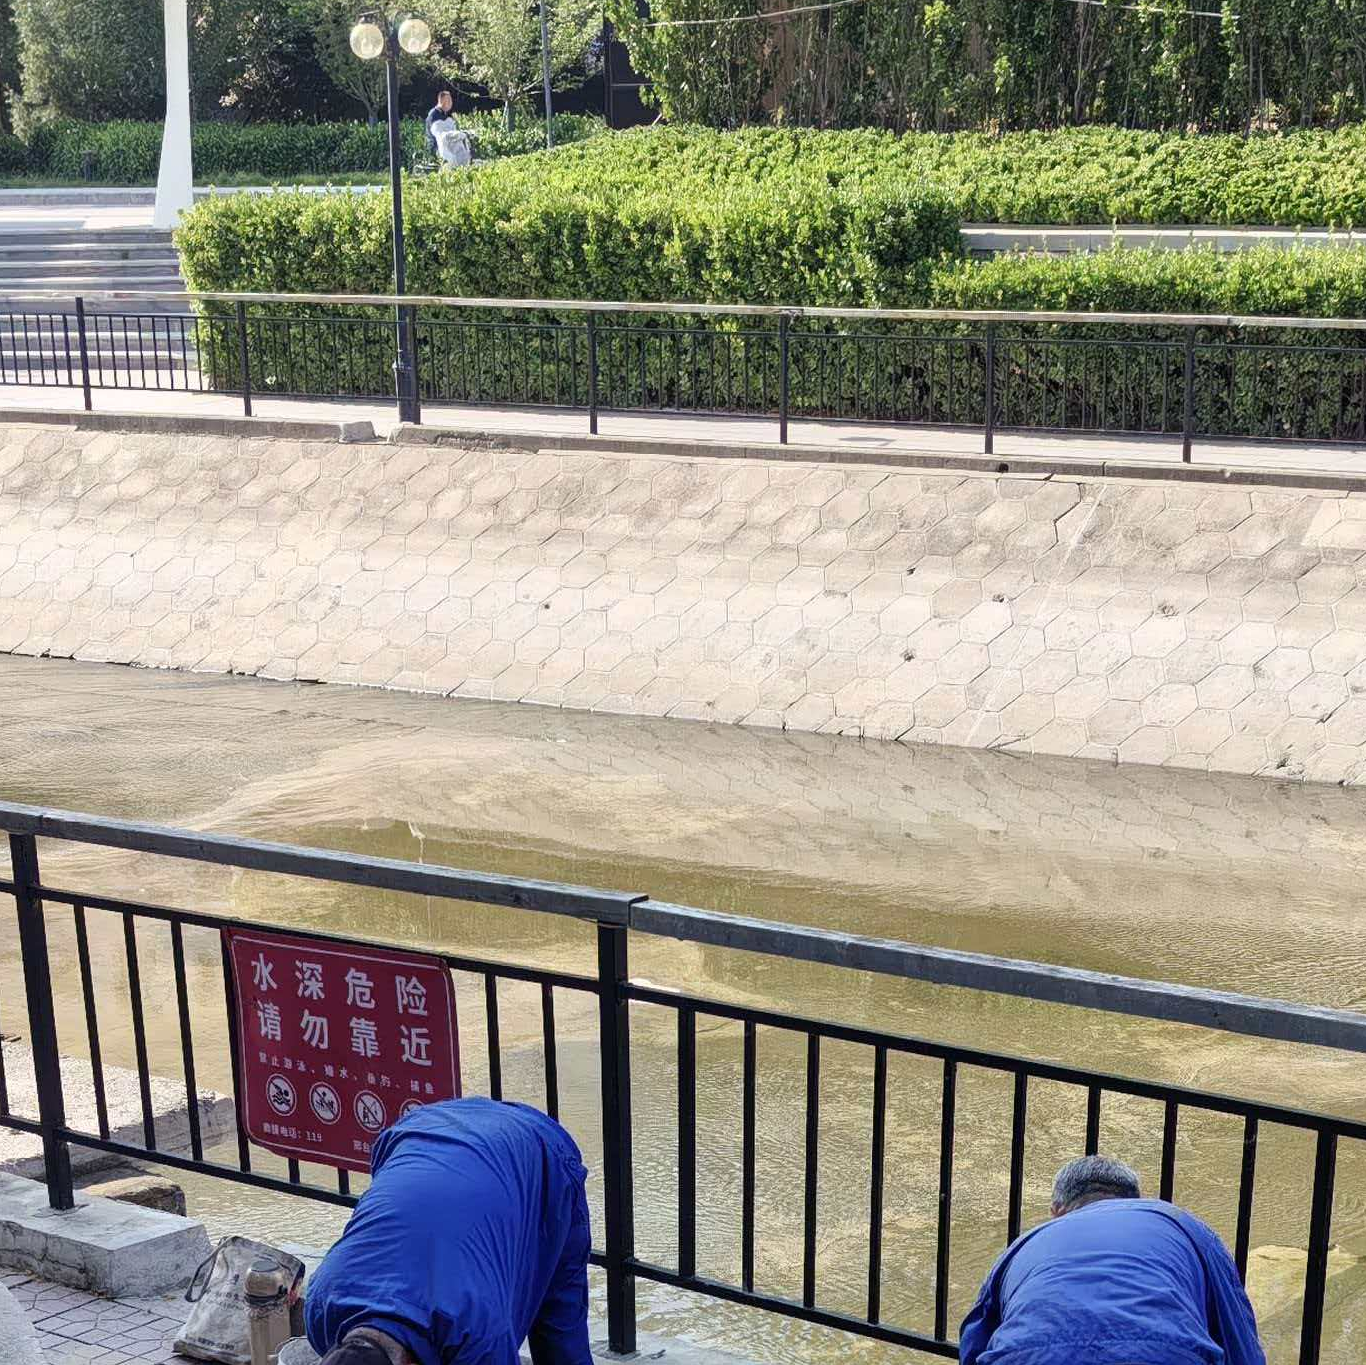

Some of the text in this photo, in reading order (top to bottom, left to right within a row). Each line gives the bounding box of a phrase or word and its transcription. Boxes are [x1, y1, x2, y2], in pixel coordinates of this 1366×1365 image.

[250, 952, 429, 1018] 水深危险
[256, 999, 433, 1067] 请勿靠近
